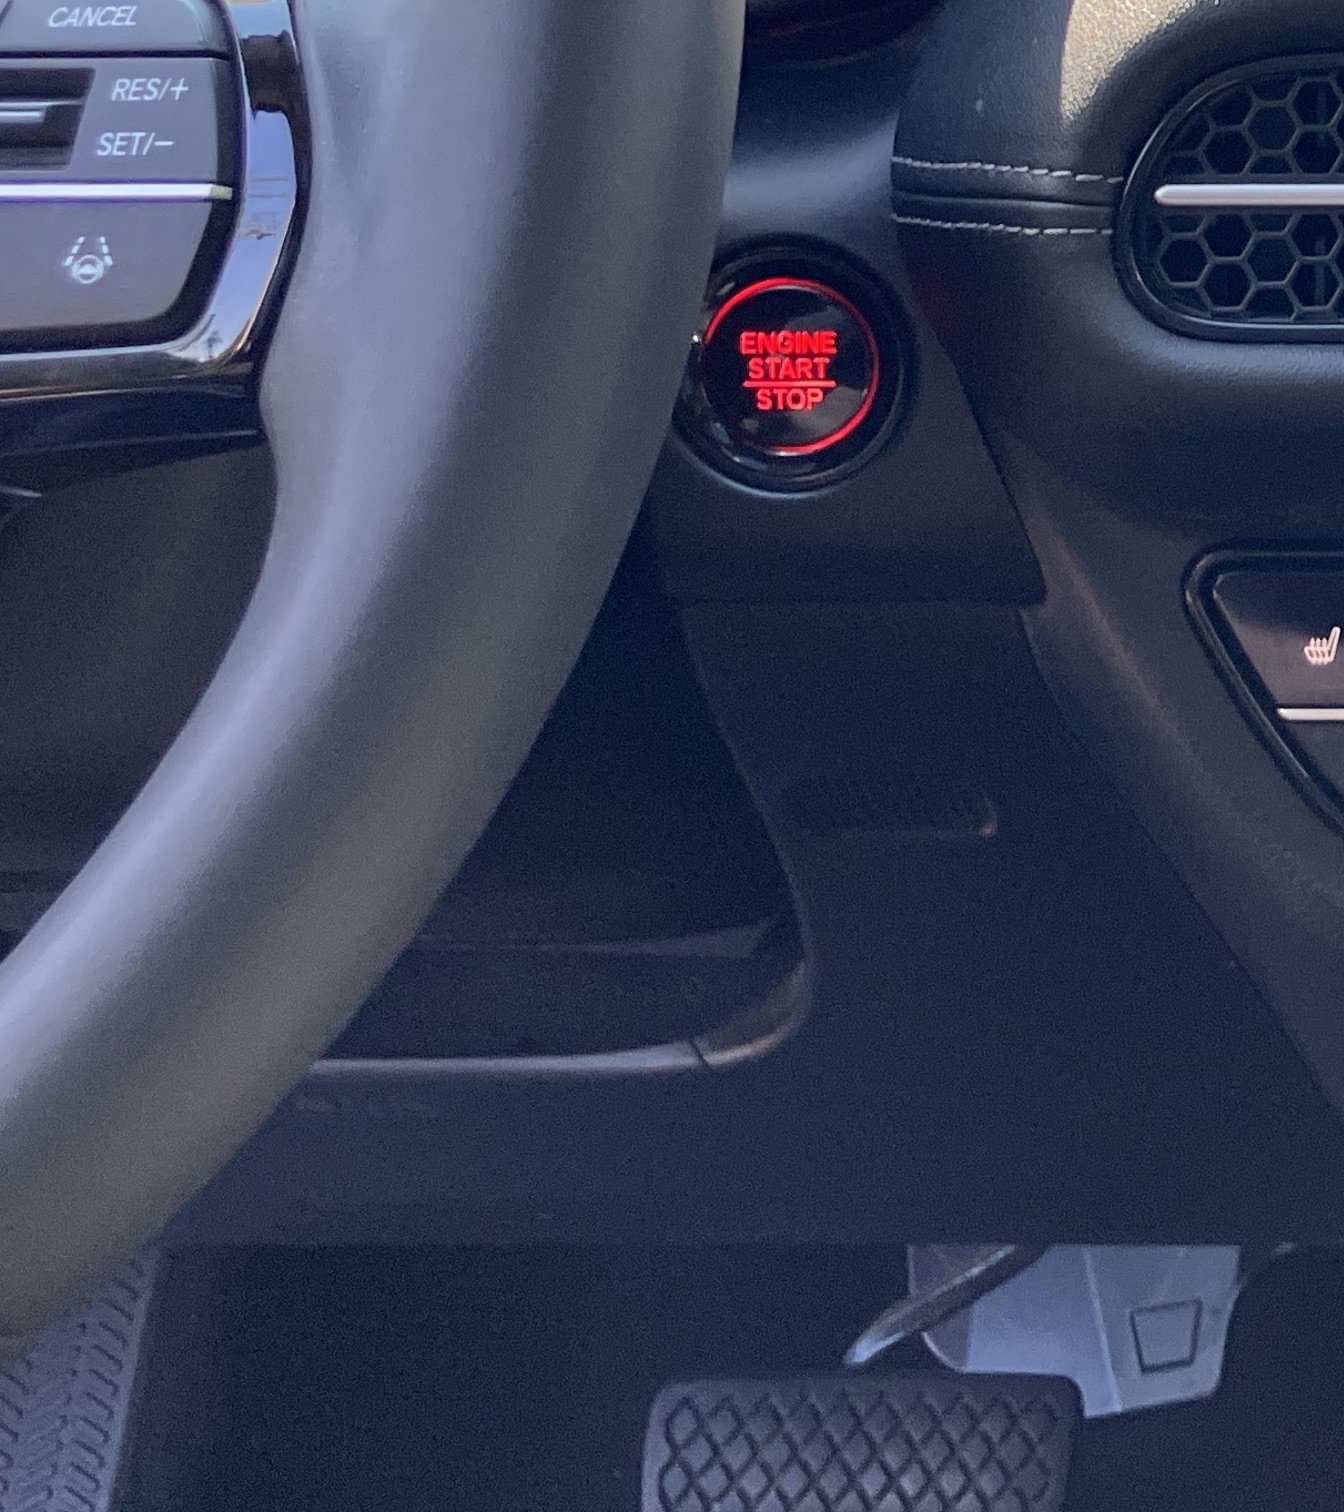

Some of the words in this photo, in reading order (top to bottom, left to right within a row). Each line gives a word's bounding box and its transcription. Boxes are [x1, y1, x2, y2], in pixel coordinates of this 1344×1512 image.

[48, 6, 136, 27] CANCEL
[111, 78, 188, 101] RES/+
[740, 330, 838, 354] ENGINE
[748, 357, 830, 379] START
[756, 388, 823, 410] STOP
